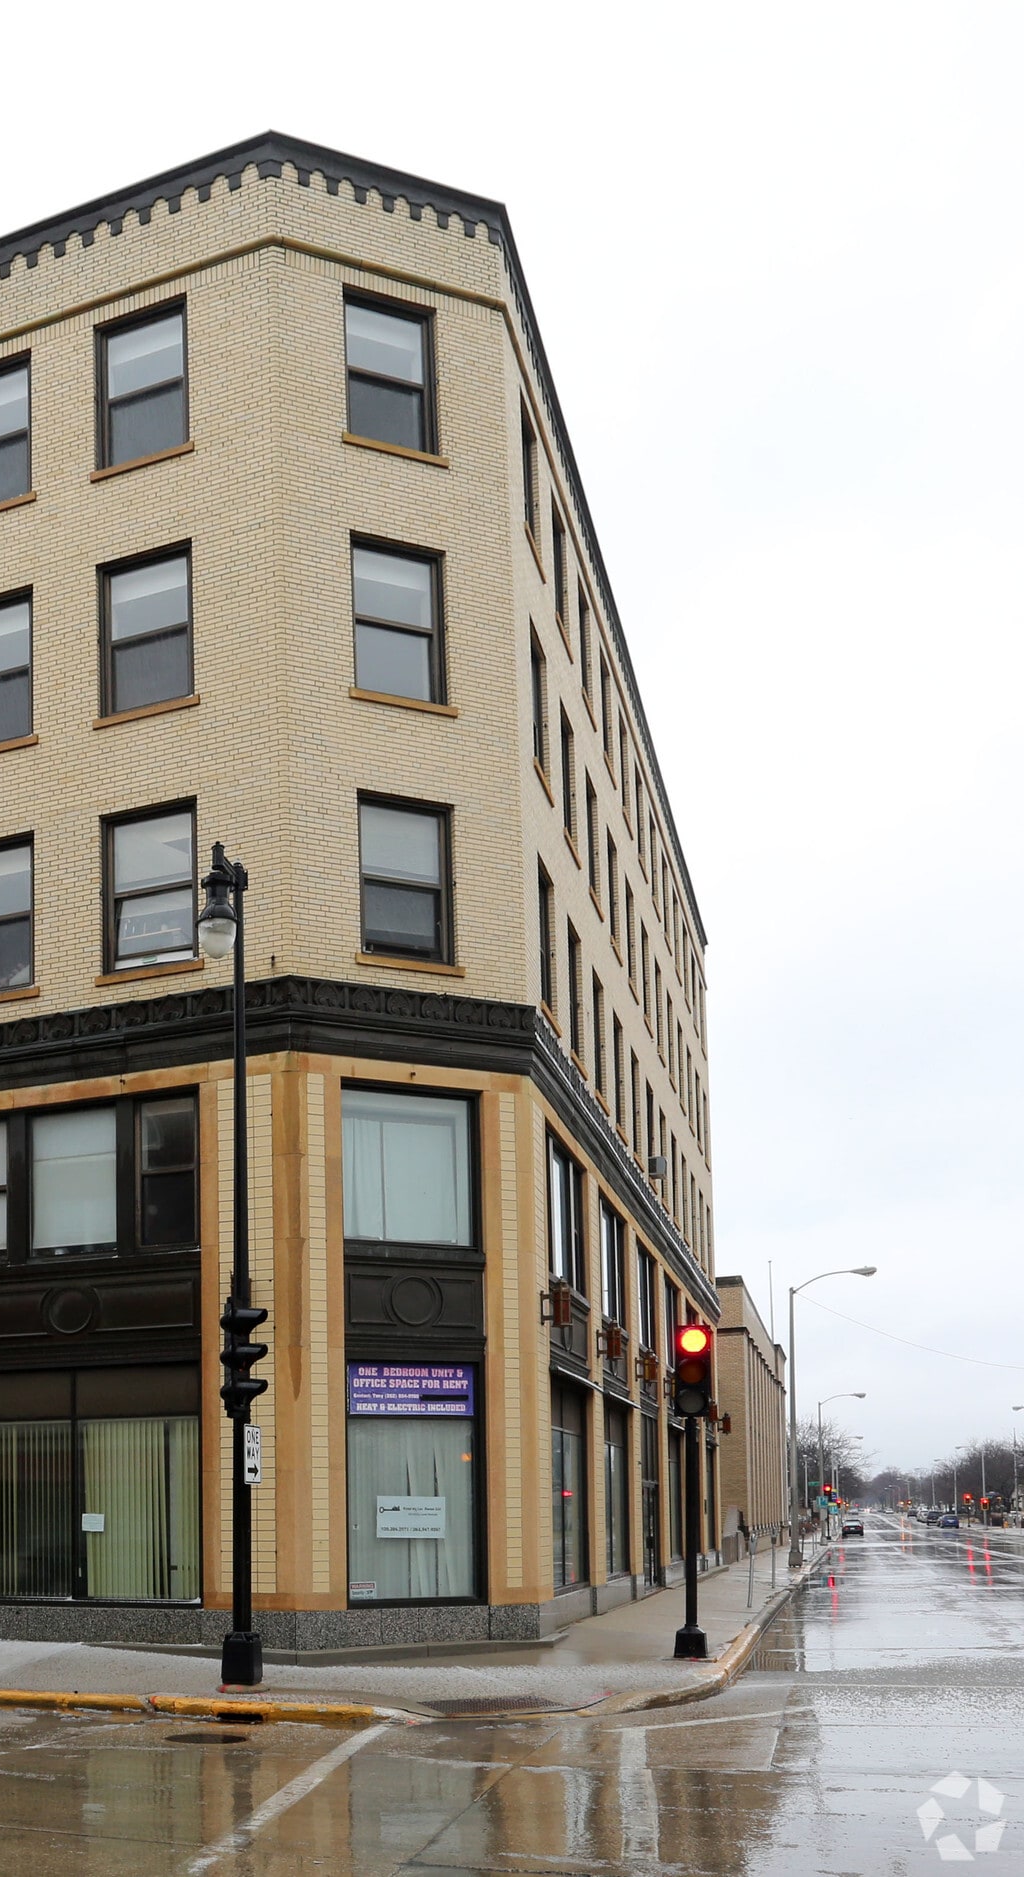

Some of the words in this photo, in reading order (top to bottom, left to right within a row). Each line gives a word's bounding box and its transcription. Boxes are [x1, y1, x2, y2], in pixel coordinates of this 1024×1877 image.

[358, 1366, 378, 1377] ONE
[383, 1367, 429, 1378] BEDROOM
[431, 1368, 455, 1378] UNIT
[457, 1369, 464, 1378] &
[353, 1378, 387, 1388] OFFICE
[389, 1378, 420, 1389] SPACE
[422, 1379, 441, 1389] FOR
[443, 1380, 469, 1390] RENT
[356, 1402, 378, 1411] HEAT
[380, 1403, 386, 1411] &
[387, 1403, 426, 1411] ELECTRIC
[427, 1403, 466, 1412] INCLUDED
[247, 1430, 260, 1445] ONE
[247, 1447, 260, 1460] WAY
